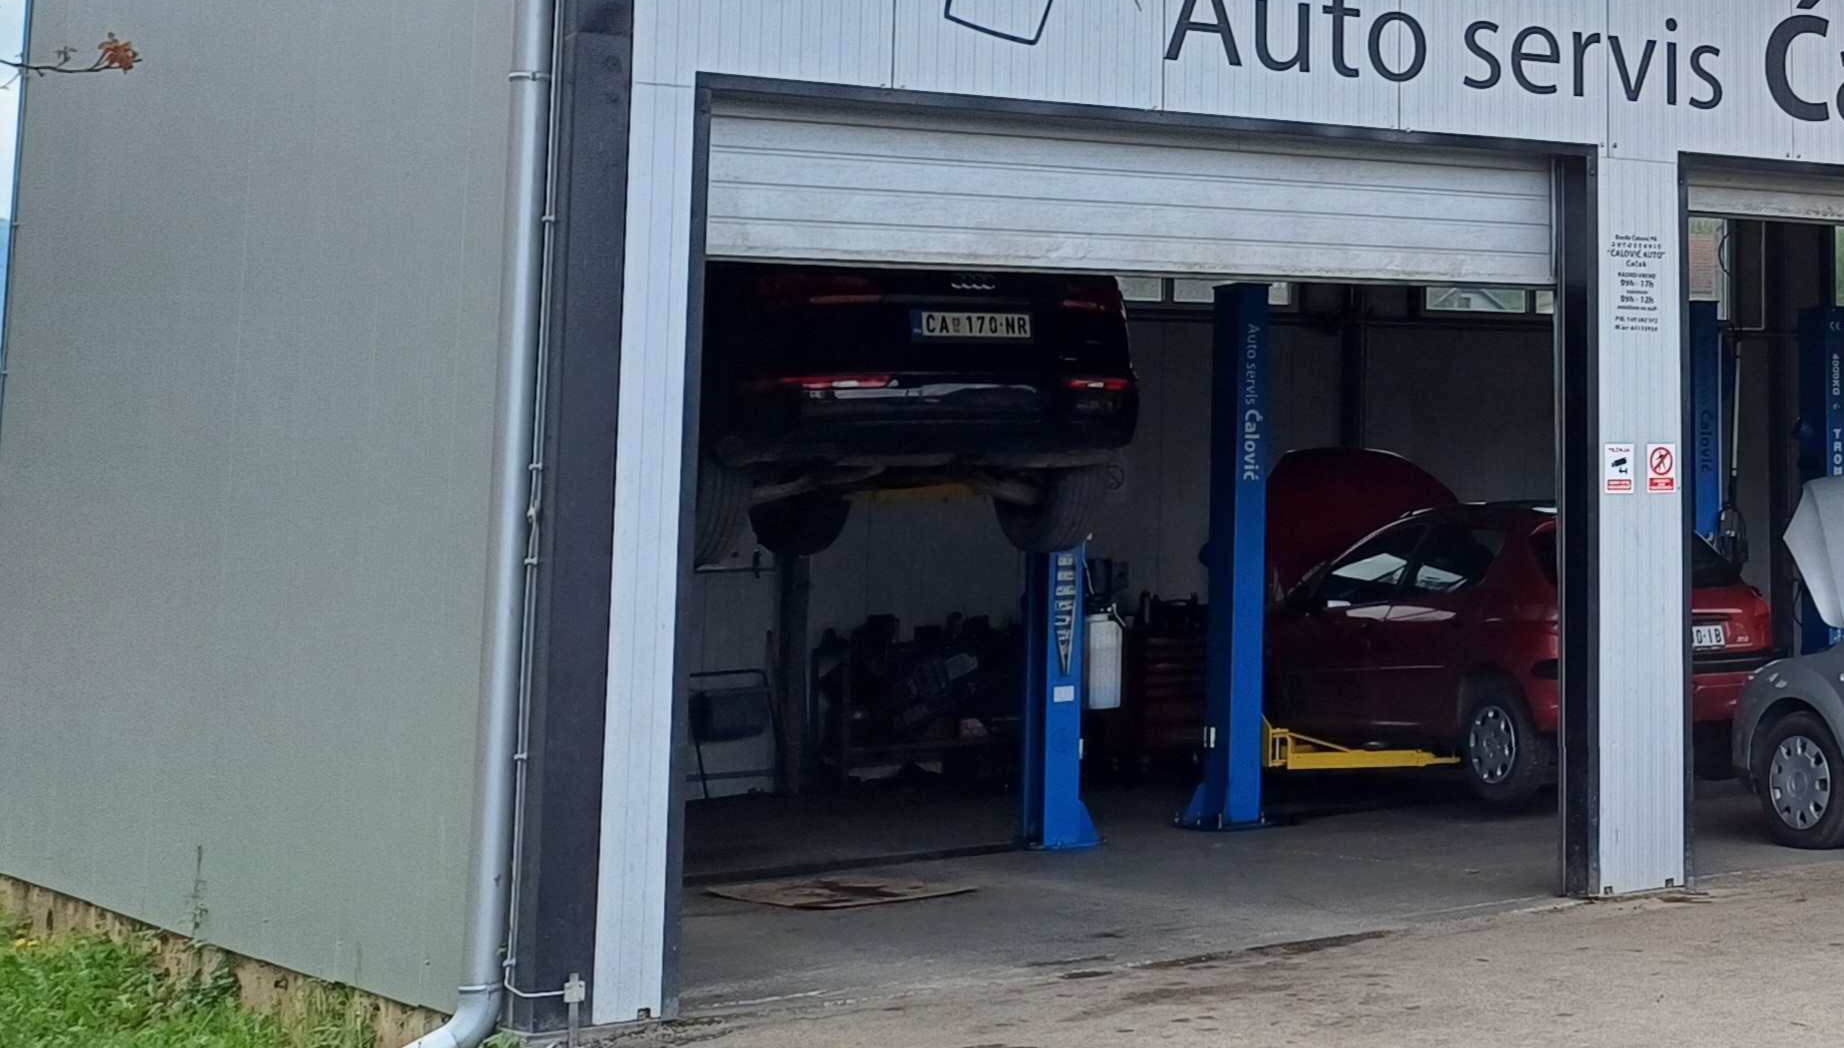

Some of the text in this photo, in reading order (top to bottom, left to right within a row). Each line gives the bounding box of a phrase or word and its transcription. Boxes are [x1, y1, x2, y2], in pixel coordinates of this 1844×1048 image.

[1463, 18, 1723, 110] servis
[926, 314, 949, 334] CA
[1248, 323, 1260, 359] Auto
[1245, 363, 1258, 405] servis
